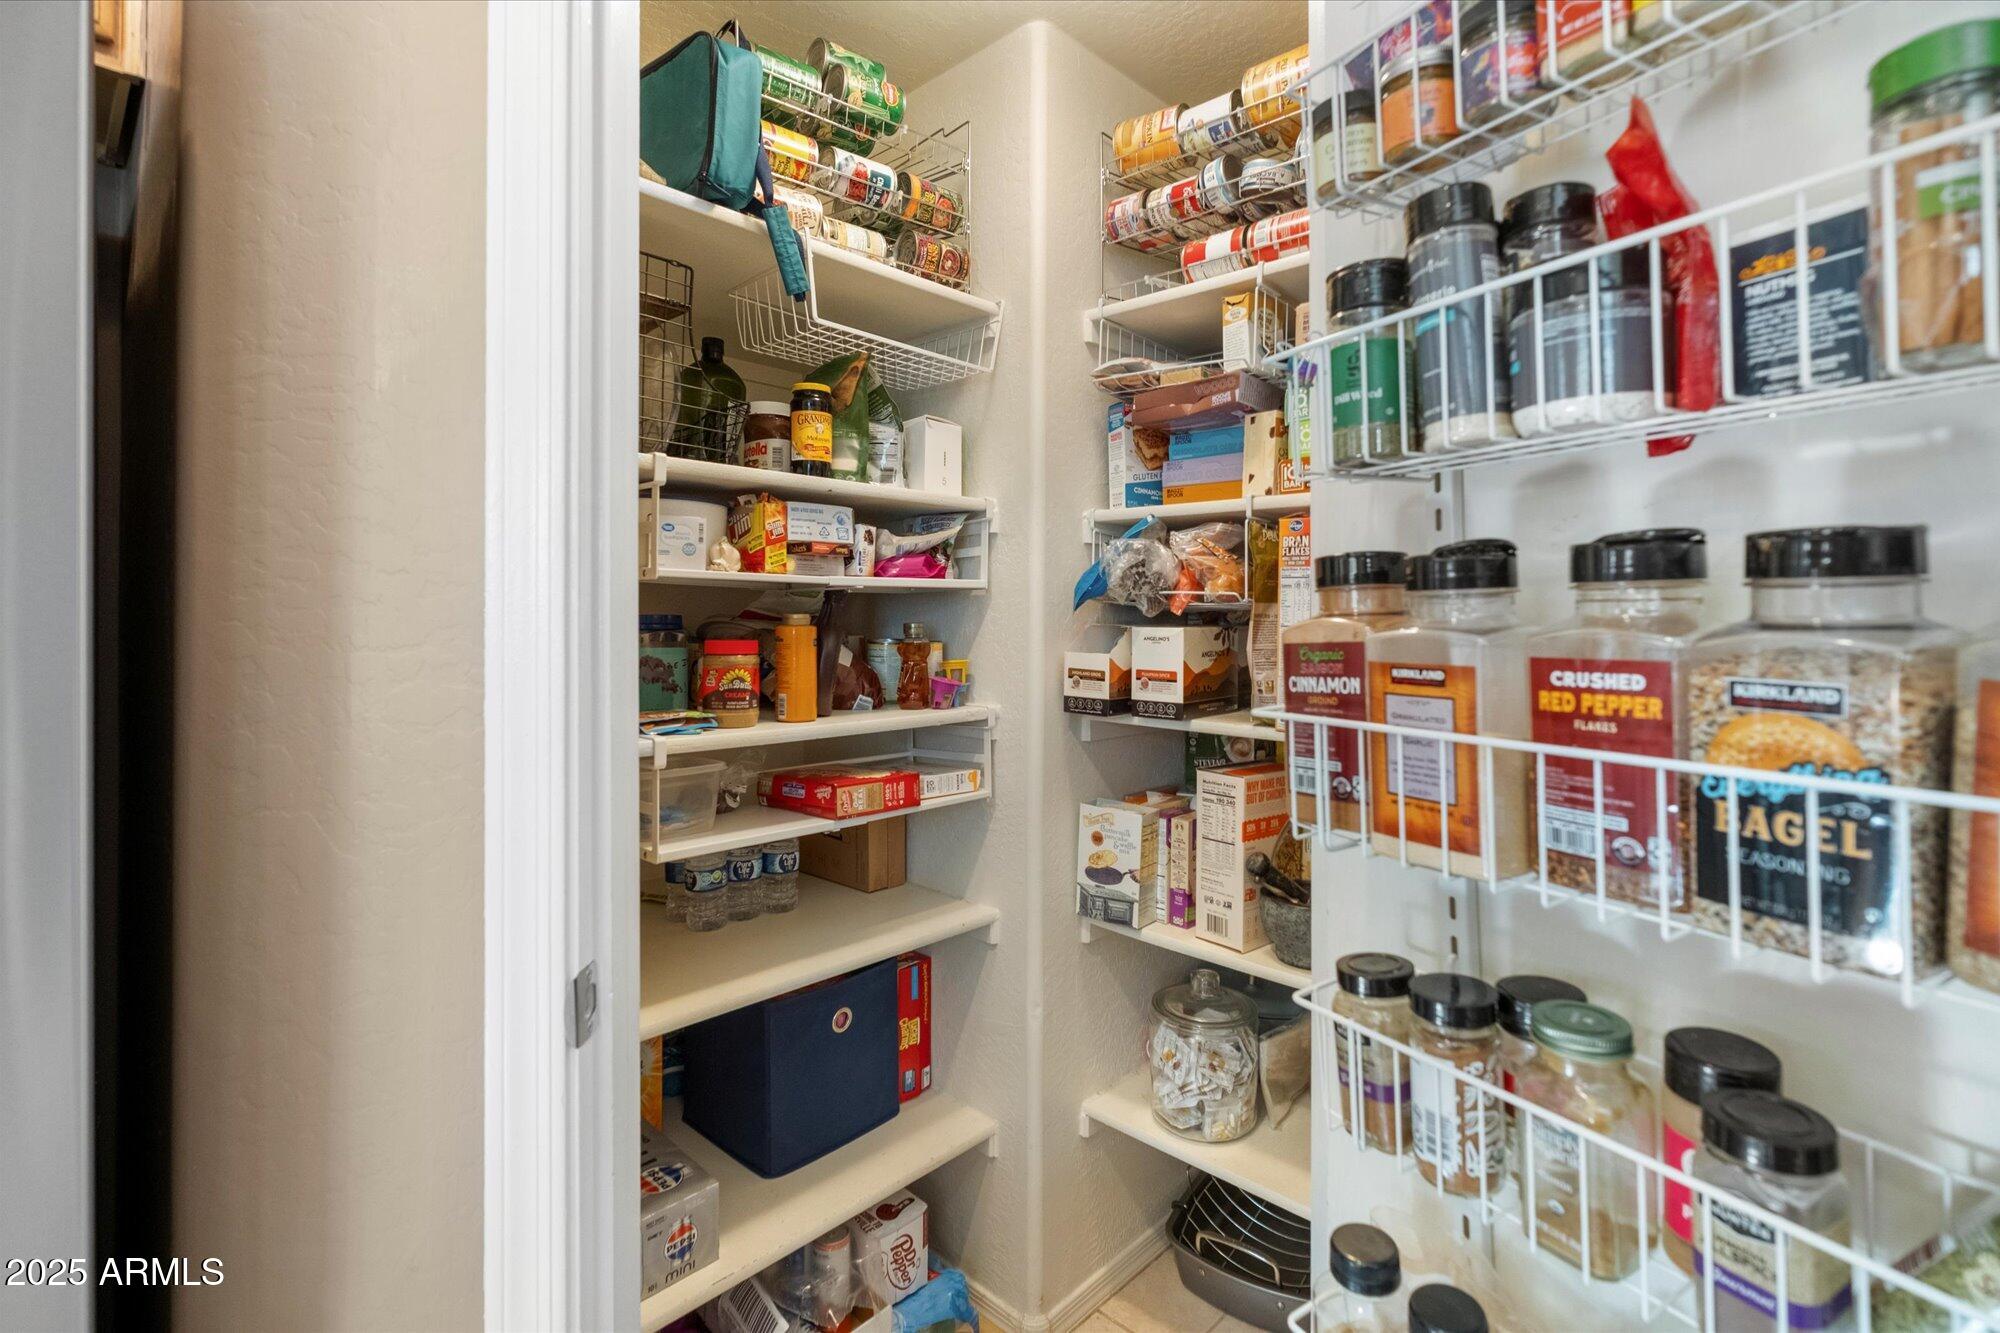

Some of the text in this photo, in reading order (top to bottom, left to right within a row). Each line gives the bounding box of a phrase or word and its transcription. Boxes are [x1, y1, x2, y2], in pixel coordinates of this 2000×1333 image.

[1745, 268, 1816, 297] NUTMG
[1133, 486, 1160, 497] CINNAMO
[1283, 536, 1309, 547] BRAN
[1282, 547, 1310, 556] FLAKES
[1301, 647, 1344, 663] Organic
[1301, 663, 1344, 675] SAIGON
[1391, 668, 1445, 682] KIRKLAND
[1288, 676, 1361, 695] CINNAMON
[1549, 670, 1648, 692] CRUSHED
[1307, 696, 1338, 705] GROUND
[1734, 682, 1841, 706] KIRKLAND
[1538, 690, 1664, 721] RED PEPPER
[1573, 719, 1618, 734] FLAKES
[1101, 824, 1131, 838] Buttermilk
[1725, 845, 1852, 887] EASONNG
[666, 1232, 696, 1254] PEPSI
[890, 1234, 913, 1285] Pepper
[665, 1259, 696, 1285] mini
